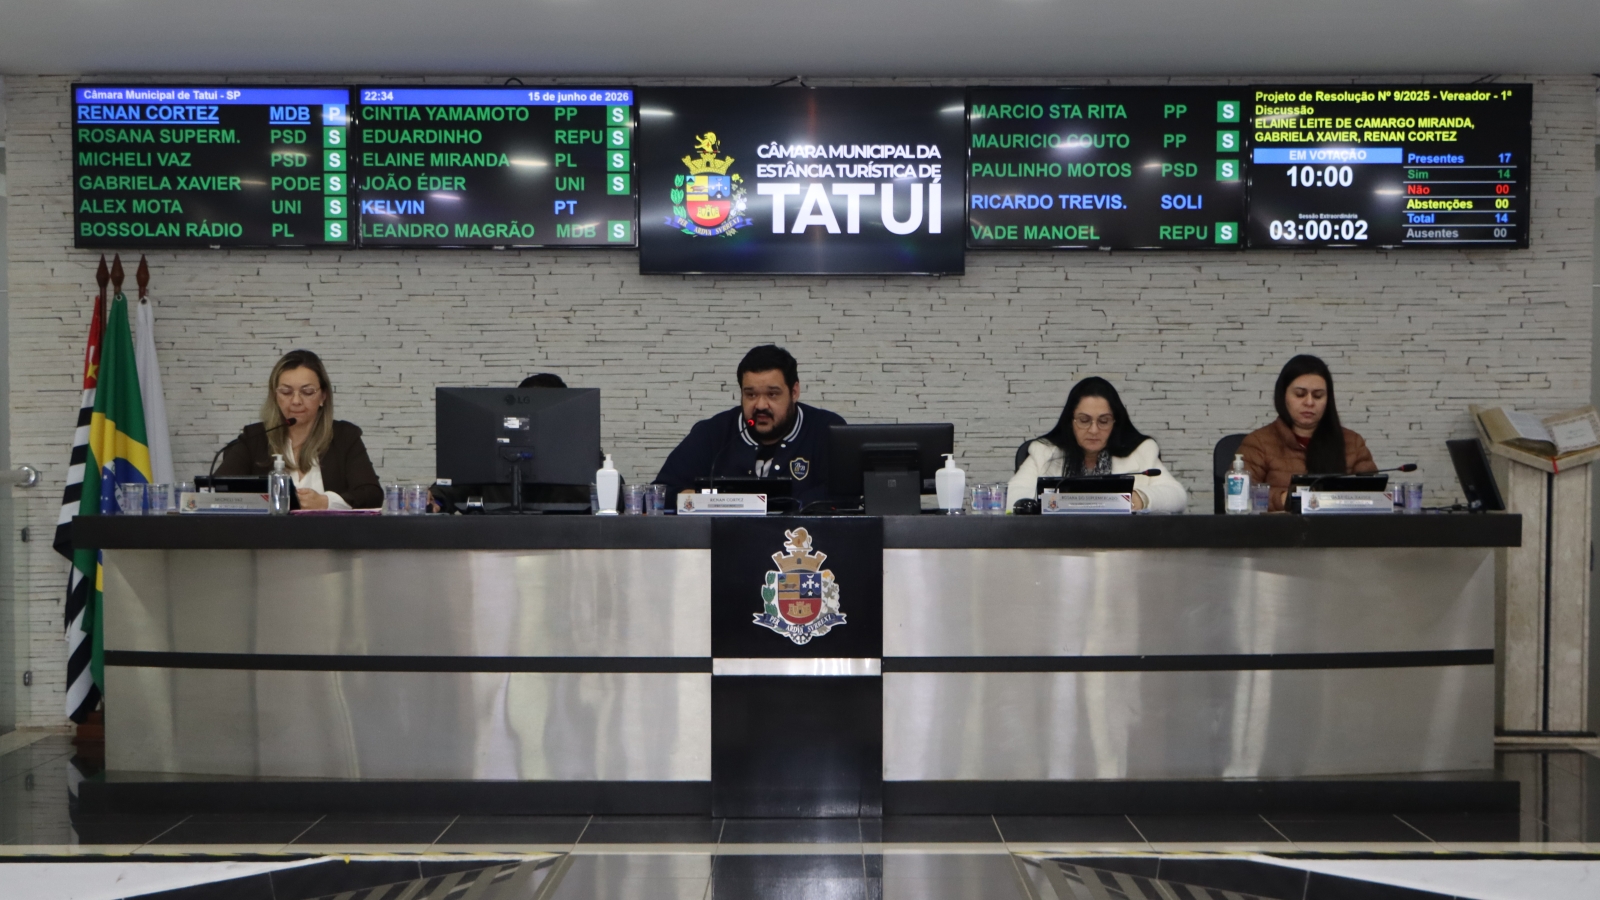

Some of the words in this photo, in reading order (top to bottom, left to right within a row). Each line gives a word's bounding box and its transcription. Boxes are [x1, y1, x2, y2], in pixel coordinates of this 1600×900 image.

[84, 90, 123, 100] Câmara
[125, 90, 175, 101] Municipal
[178, 91, 190, 100] de
[226, 91, 241, 100] SP
[365, 92, 394, 101] 22:34
[528, 92, 539, 101] 15
[542, 92, 555, 101] de
[557, 92, 587, 103] junho
[589, 92, 602, 101] de
[605, 92, 629, 101] 2026
[1255, 92, 1296, 104] Projeto
[1299, 92, 1312, 102] de
[1315, 92, 1375, 104] Resolução
[1378, 92, 1391, 101] Nº
[1394, 91, 1430, 101] 9/2025
[1440, 91, 1489, 101] Vereador
[1501, 91, 1512, 101] 1ª
[78, 106, 140, 120] RENAN
[146, 106, 219, 120] CORTEZ
[270, 106, 310, 121] MDB
[330, 107, 340, 121] P
[362, 106, 421, 121] CINTIA
[425, 106, 529, 121] YAMAMOTO
[555, 107, 578, 121] PP
[612, 108, 624, 122] S
[972, 105, 1043, 119] MARCIO
[1049, 105, 1083, 119] STA
[1088, 105, 1127, 119] RITA
[1164, 105, 1187, 118] PP
[1222, 105, 1234, 119] S
[1255, 105, 1314, 115] Discussão
[1255, 118, 1297, 128] ELAINE
[1299, 118, 1334, 128] LEITE
[1337, 118, 1352, 128] DE
[1354, 118, 1415, 128] CAMARGO
[1418, 118, 1475, 130] MIRANDA,
[78, 129, 155, 144] ROSANA
[160, 129, 240, 144] SUPERM.
[270, 130, 307, 144] PSD
[329, 131, 340, 144] S
[362, 130, 482, 144] EDUARDINHO
[555, 130, 603, 144] REPU
[612, 131, 624, 145] S
[972, 134, 1061, 148] MAURICIO
[1067, 134, 1130, 148] COUTO
[1163, 135, 1187, 147] PP
[1222, 134, 1234, 148] S
[1255, 132, 1315, 142] GABRIELA
[1317, 132, 1361, 143] XAVIER,
[1364, 131, 1405, 142] RENAN
[1408, 131, 1457, 142] CORTEZ
[757, 141, 827, 159] CÂMARA
[829, 144, 915, 159] MUNICIPAL
[917, 145, 941, 159] DA
[1289, 151, 1307, 160] EM
[1310, 149, 1367, 163] VOTAÇÃO
[79, 153, 151, 167] MICHELI
[157, 153, 191, 167] VAZ
[271, 153, 307, 167] PSD
[329, 154, 341, 167] S
[363, 153, 425, 167] ELAINE
[430, 153, 510, 167] MIRANDA
[555, 153, 577, 167] PL
[612, 154, 624, 168] S
[1408, 154, 1465, 163] Presentes
[1498, 154, 1511, 163] 17
[757, 161, 833, 178] ESTÂNCIA
[836, 160, 916, 178] TURÍSTICA
[919, 165, 941, 178] DE
[971, 163, 1062, 177] PAULINHO
[1067, 163, 1131, 177] MOTOS
[1162, 163, 1198, 177] PSD
[1222, 163, 1233, 177] S
[1407, 170, 1429, 179] Sim
[1497, 169, 1511, 178] 14
[79, 176, 171, 191] GABRIELA
[176, 176, 241, 191] XAVIER
[271, 177, 321, 191] PODE
[329, 178, 341, 191] S
[362, 173, 411, 191] JOÃO
[417, 172, 466, 191] ÉDER
[555, 177, 585, 191] UNI
[612, 177, 624, 191] S
[1286, 166, 1353, 187] 10:00
[1407, 185, 1430, 194] Não
[1496, 185, 1509, 194] 00
[80, 199, 127, 214] ALEX
[132, 199, 183, 214] MOTA
[272, 200, 301, 214] UNI
[330, 201, 341, 215] S
[362, 200, 425, 214] KELVIN
[554, 201, 577, 214] PT
[757, 177, 942, 235] TATUÍ
[971, 195, 1053, 209] RICARDO
[1058, 195, 1127, 209] TREVIS.
[1161, 195, 1202, 209] SOLI
[1407, 199, 1473, 210] Abstenções
[1495, 199, 1509, 209] 00
[1407, 214, 1435, 223] Total
[1495, 214, 1508, 223] 14
[80, 222, 180, 237] BOSSOLAN
[186, 218, 242, 237] RÁDIO
[272, 224, 294, 238] PL
[330, 224, 342, 238] S
[362, 223, 448, 238] LEANDRO
[455, 220, 535, 238] MAGRÃO
[557, 224, 596, 238] MDB
[613, 224, 625, 238] S
[971, 226, 1018, 240] VADE
[1024, 225, 1100, 240] MANOEL
[1159, 226, 1208, 240] REPU
[1221, 226, 1233, 240] S
[1270, 220, 1368, 240] 03:00:02
[1406, 229, 1459, 238] Ausentes
[1494, 228, 1507, 237] 00
[517, 396, 530, 404] LG
[770, 616, 780, 625] PER
